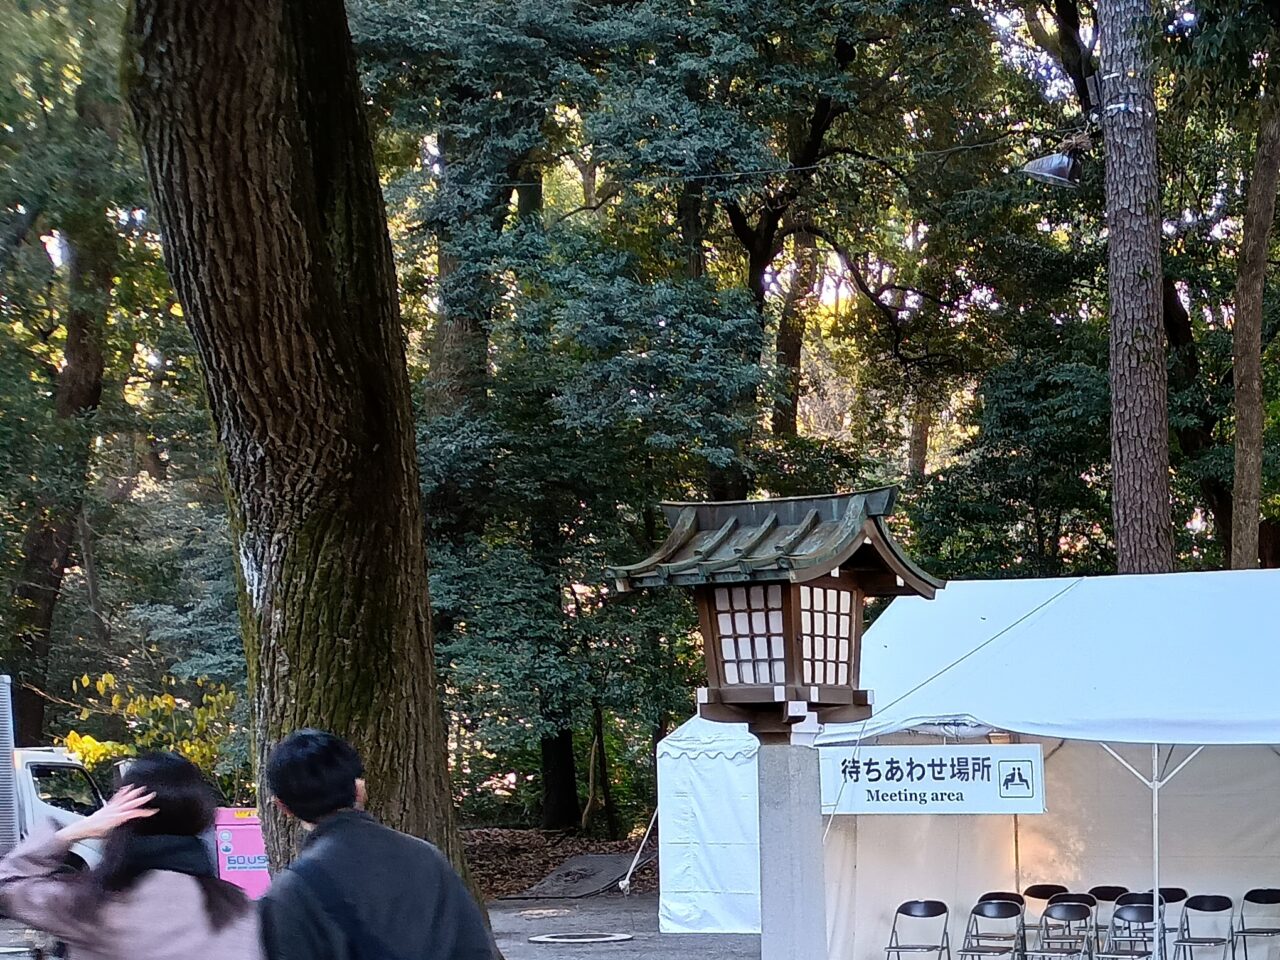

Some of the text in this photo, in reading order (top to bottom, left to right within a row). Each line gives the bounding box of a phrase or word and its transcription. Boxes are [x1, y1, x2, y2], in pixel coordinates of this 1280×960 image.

[841, 756, 992, 783] 待ちあわせ場所
[866, 789, 964, 804] Meeting area
